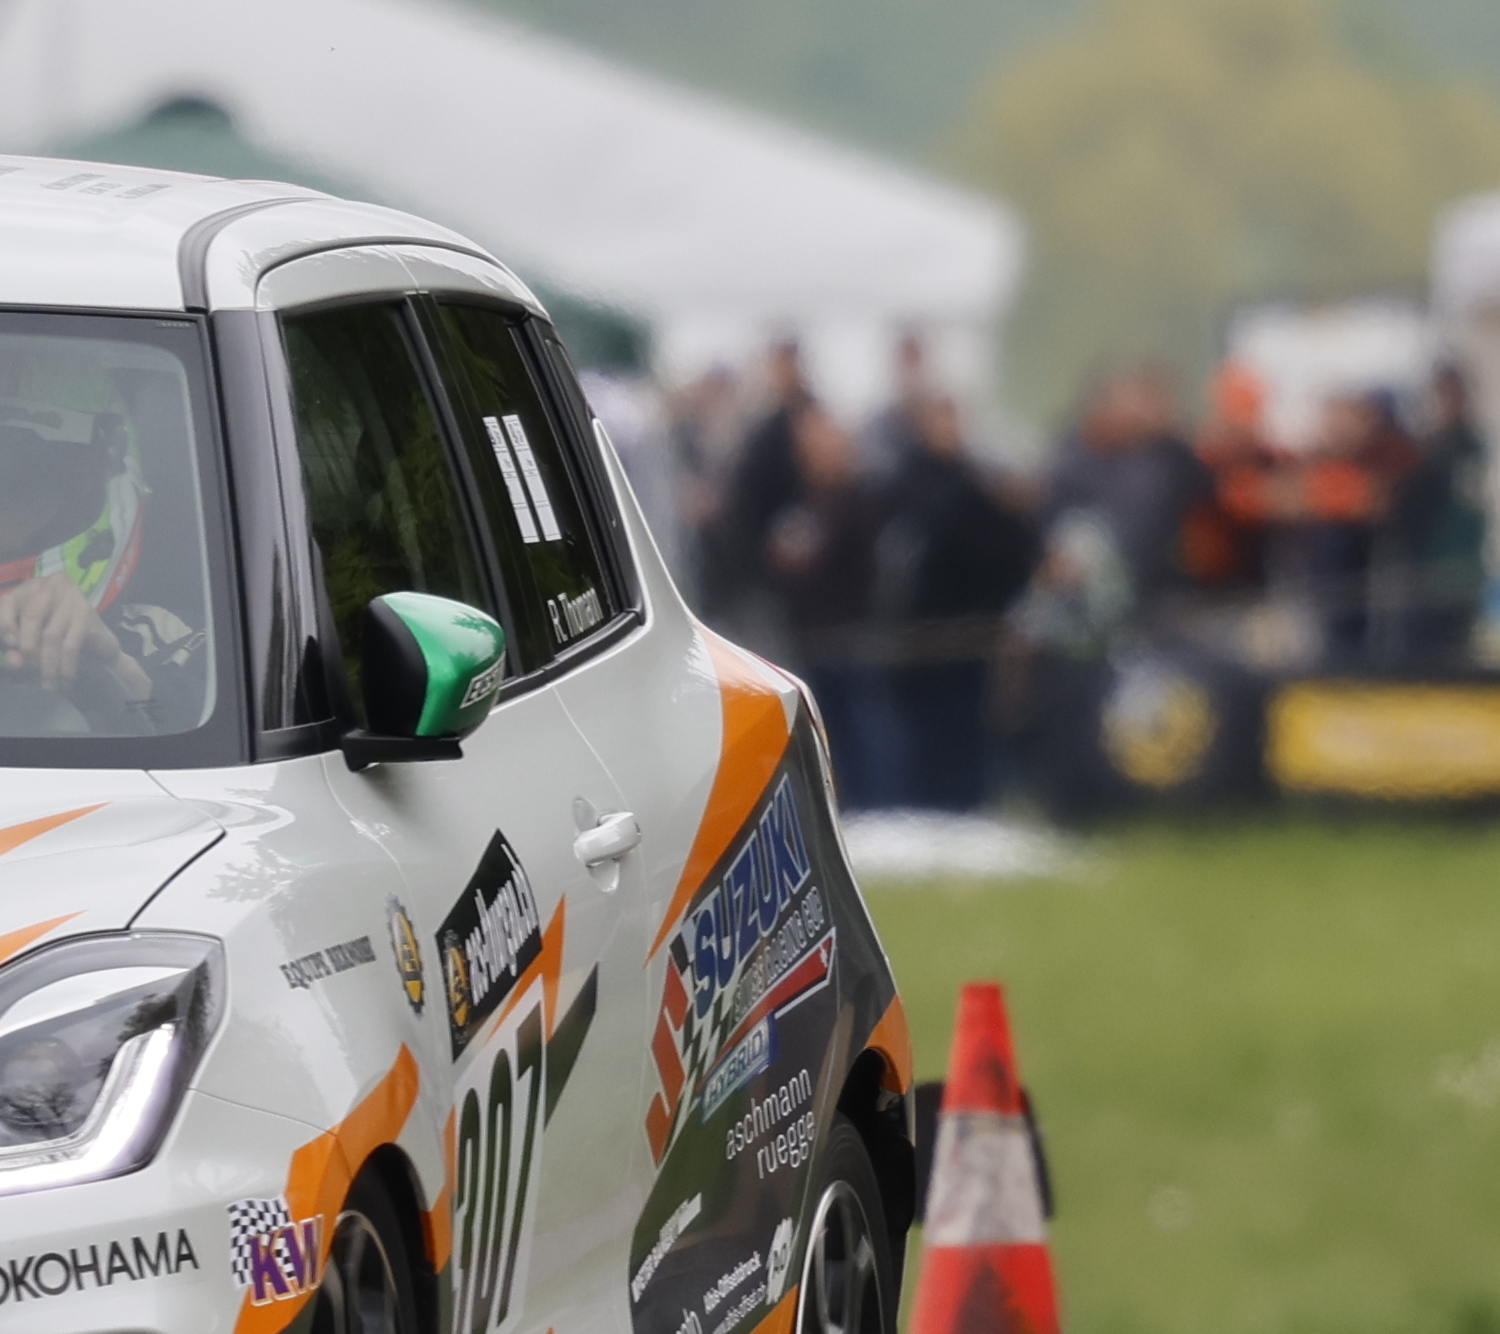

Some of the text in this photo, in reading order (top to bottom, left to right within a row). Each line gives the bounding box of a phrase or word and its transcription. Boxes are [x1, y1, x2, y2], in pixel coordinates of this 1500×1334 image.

[694, 773, 811, 1020] SUZUKI
[733, 955, 765, 1023] SWISS
[764, 910, 809, 986] RACING
[704, 1027, 766, 1113] HYBRID
[726, 1068, 812, 1161] aschmann
[756, 1111, 816, 1179] ruegge
